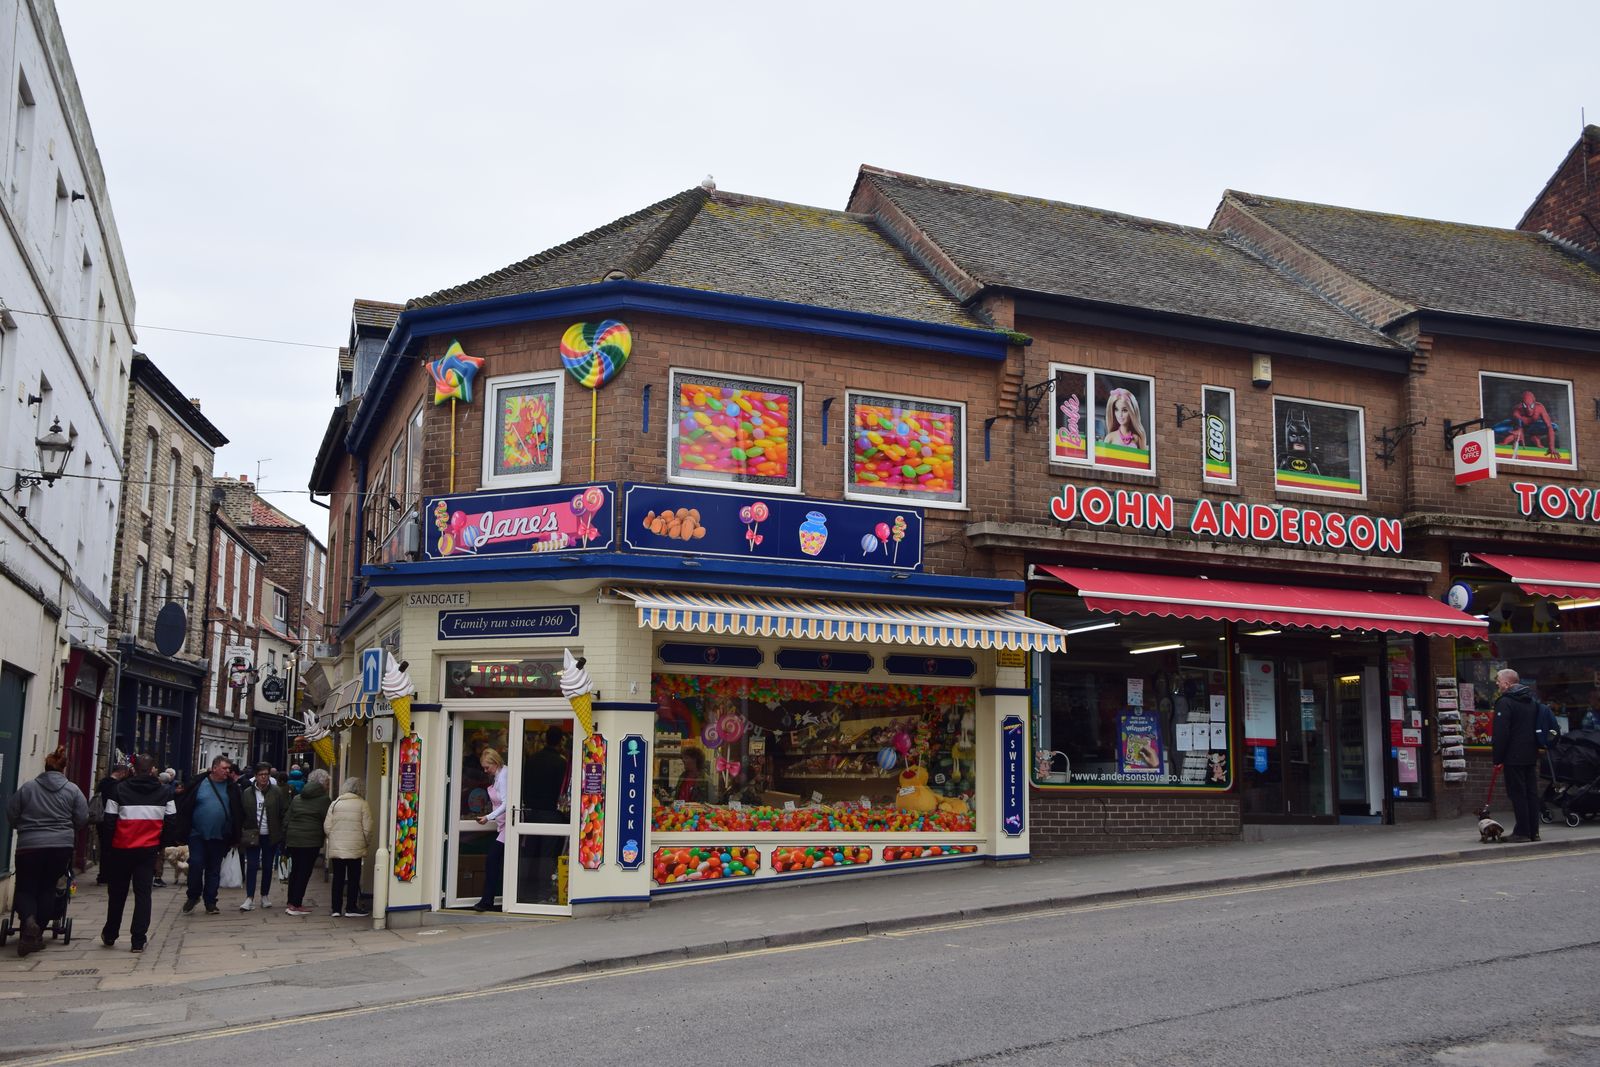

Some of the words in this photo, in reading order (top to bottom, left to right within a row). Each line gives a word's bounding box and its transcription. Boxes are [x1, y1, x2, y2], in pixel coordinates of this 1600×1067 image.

[1058, 394, 1081, 447] Barbie
[1208, 416, 1225, 461] LEGO
[1462, 450, 1480, 460] OFFICE
[1464, 444, 1478, 453] POST
[474, 507, 559, 547] Jane's
[1050, 483, 1174, 531] JOHN
[1190, 499, 1402, 553] ANDERSON
[410, 593, 464, 604] SANDGATE
[453, 617, 489, 631] Family
[490, 620, 508, 628] run
[510, 616, 536, 627] since
[538, 614, 563, 626] 1960
[1008, 739, 1017, 807] SWEETS
[628, 773, 636, 830] ROCK
